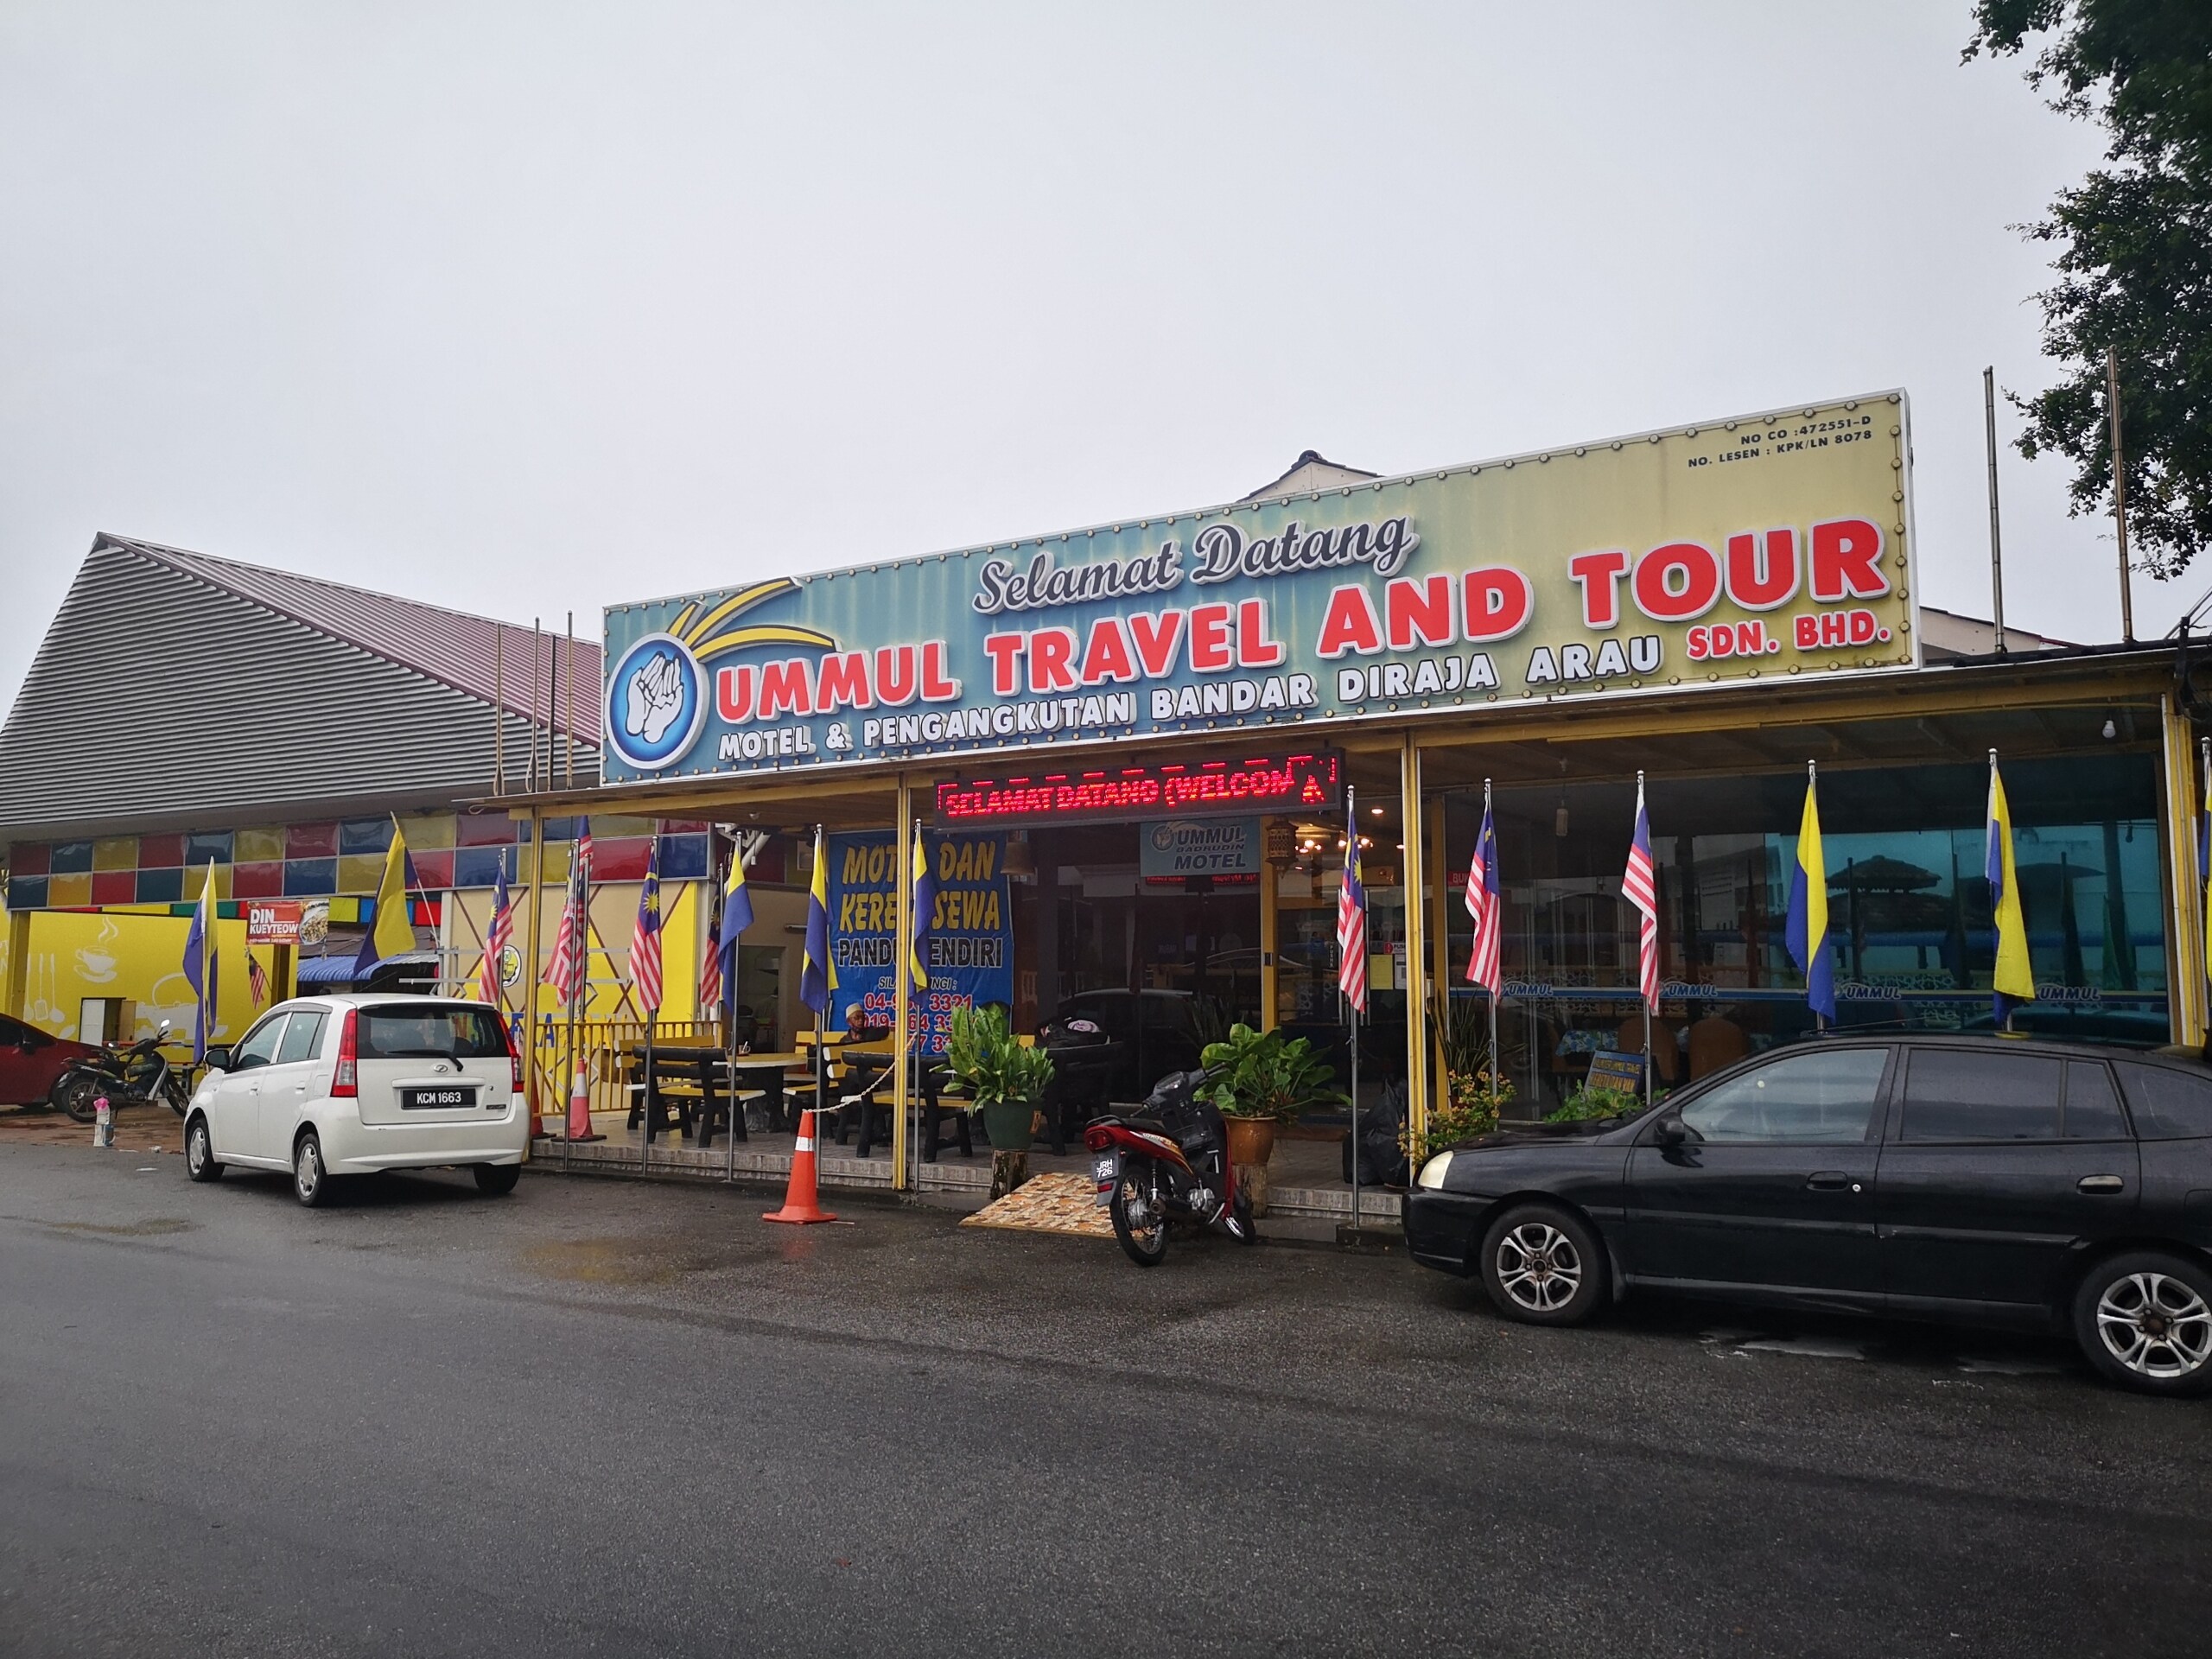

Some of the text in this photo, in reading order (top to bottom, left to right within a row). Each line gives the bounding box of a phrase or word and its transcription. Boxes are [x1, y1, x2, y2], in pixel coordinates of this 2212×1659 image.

[1741, 434, 1761, 445] NO
[1768, 429, 1788, 441] CO
[1688, 456, 1713, 467] NO.
[1719, 448, 1759, 463] LESEN
[1777, 437, 1828, 454] KPK/LN
[1834, 430, 1872, 444] 8078
[974, 516, 1414, 611] Selamat Datang
[717, 518, 1889, 722] UMMUL TRAVEL AND TOUR
[1688, 611, 1891, 658] SDN. BHD.
[718, 635, 1661, 761] MOTEL & PENGANGKUTAN BANDAR DIRAJA ARAU
[1177, 826, 1246, 845] UMMUL
[939, 841, 996, 881] DAN
[1174, 853, 1246, 870] MOTEL
[251, 908, 275, 925] DIN
[932, 890, 1000, 931] SEWA
[250, 924, 298, 934] KUEYTEOW
[929, 937, 1002, 968] ENDIRI
[1509, 984, 1554, 996] UMMUL
[1669, 984, 1718, 996] UMMUL
[1846, 987, 1901, 1000] UMMUL
[2038, 987, 2101, 1001] UMMUL
[416, 1091, 461, 1104] KCM 1663
[1096, 1159, 1113, 1170] JRH
[1096, 1167, 1113, 1178] 726
